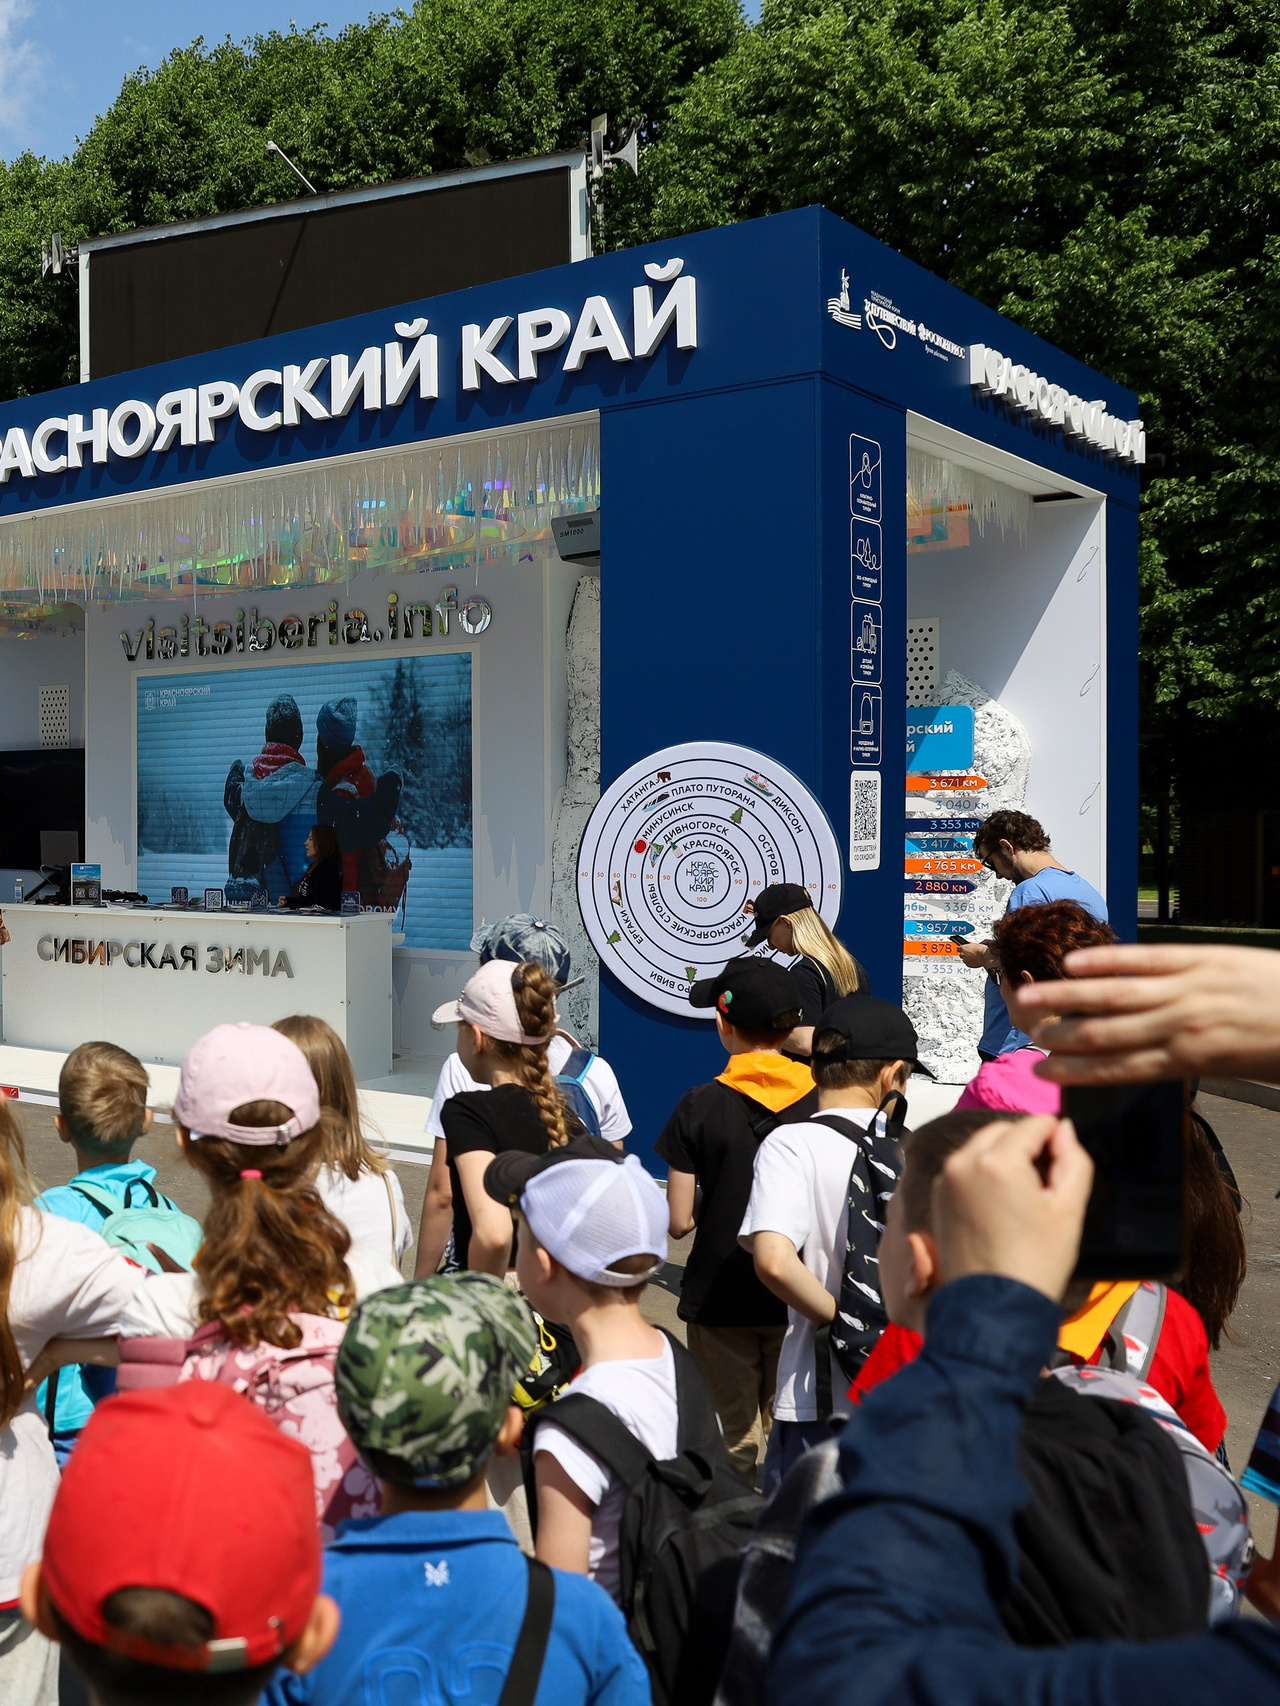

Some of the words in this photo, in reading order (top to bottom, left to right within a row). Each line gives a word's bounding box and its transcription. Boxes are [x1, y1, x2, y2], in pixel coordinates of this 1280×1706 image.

[462, 257, 698, 391] КРАЙ
[560, 528, 584, 538] SM1000
[120, 587, 493, 662] visitsiberia.info
[160, 685, 211, 698] КРАСНОЯРСКИЙ
[160, 697, 177, 707] КРАЙ
[906, 720, 954, 738] рский
[929, 779, 937, 788] 3
[940, 778, 960, 788] 671
[621, 780, 657, 812] ХАТАНГА
[671, 783, 704, 797] ПЛАТО
[706, 783, 757, 809] ПУТОРАНА
[935, 800, 942, 810] 3
[945, 800, 971, 809] 040
[771, 796, 804, 834] ДИКСОН
[642, 802, 695, 840] МИНУСИНСК
[930, 820, 937, 829] 3
[940, 820, 961, 829] 353
[663, 821, 730, 844] ДИВНОГОРСК
[920, 839, 927, 849] 3
[931, 839, 949, 848] 417
[683, 839, 741, 875] КРАСНОЯРСК
[758, 834, 780, 876] ОСТРОВ
[690, 861, 715, 870] КРАС
[923, 861, 931, 870] 4
[934, 861, 957, 871] 765
[686, 869, 719, 878] НОЯРС
[694, 877, 714, 886] КИЙ
[915, 881, 922, 891] 2
[925, 882, 949, 891] 880
[689, 884, 714, 893] КРАЙ
[647, 883, 671, 923] СТОЛБЫ
[904, 902, 927, 912] лбы
[943, 902, 950, 912] 3
[952, 902, 975, 912] 368
[620, 909, 644, 944] ЕРГАКИ
[670, 914, 748, 939] КРАСНОЯРСКИЕ
[916, 923, 923, 933] 3
[926, 923, 948, 933] 957
[921, 943, 927, 953] 3
[931, 943, 952, 953] 878
[36, 936, 199, 972] СИБИРСКАЯ
[205, 946, 295, 979] ЗИМА
[922, 964, 929, 974] 3
[932, 964, 953, 974] 353
[650, 971, 676, 989] ВИВИ
[677, 983, 690, 993] РО
